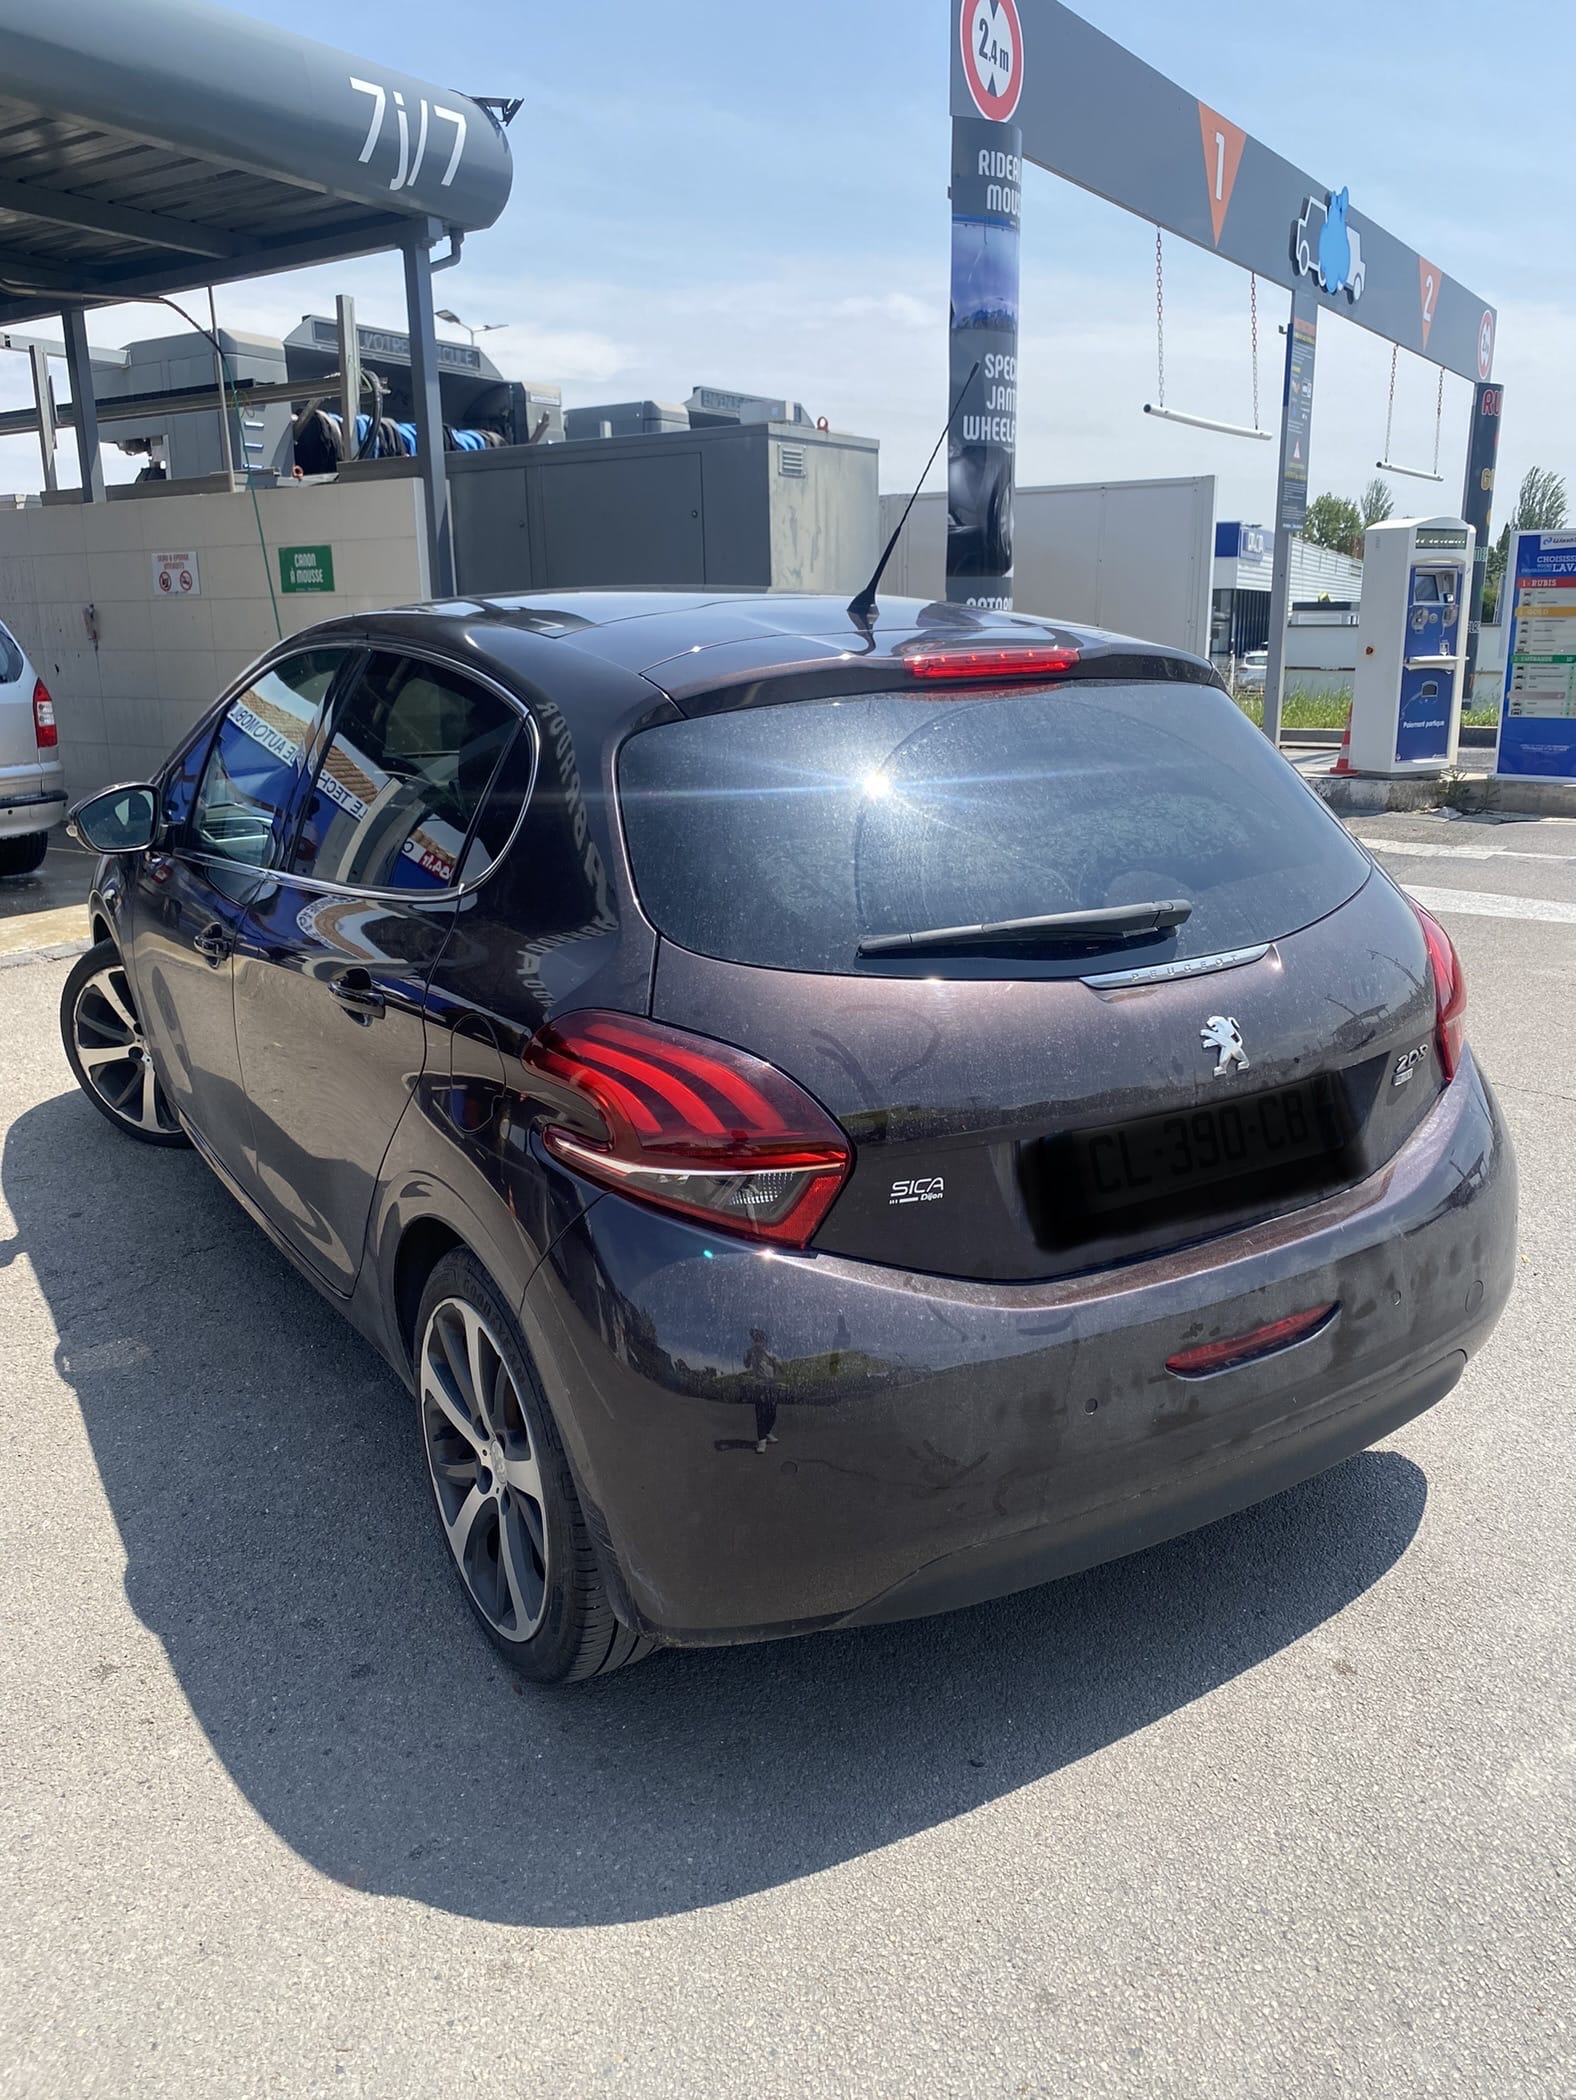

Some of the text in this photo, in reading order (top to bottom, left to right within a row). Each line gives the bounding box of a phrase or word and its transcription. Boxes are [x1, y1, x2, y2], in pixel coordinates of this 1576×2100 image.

[1215, 132, 1225, 200] 1
[1423, 274, 1433, 322] 2
[1130, 955, 1240, 982] PEUGEOT
[890, 1176, 944, 1197] SICA
